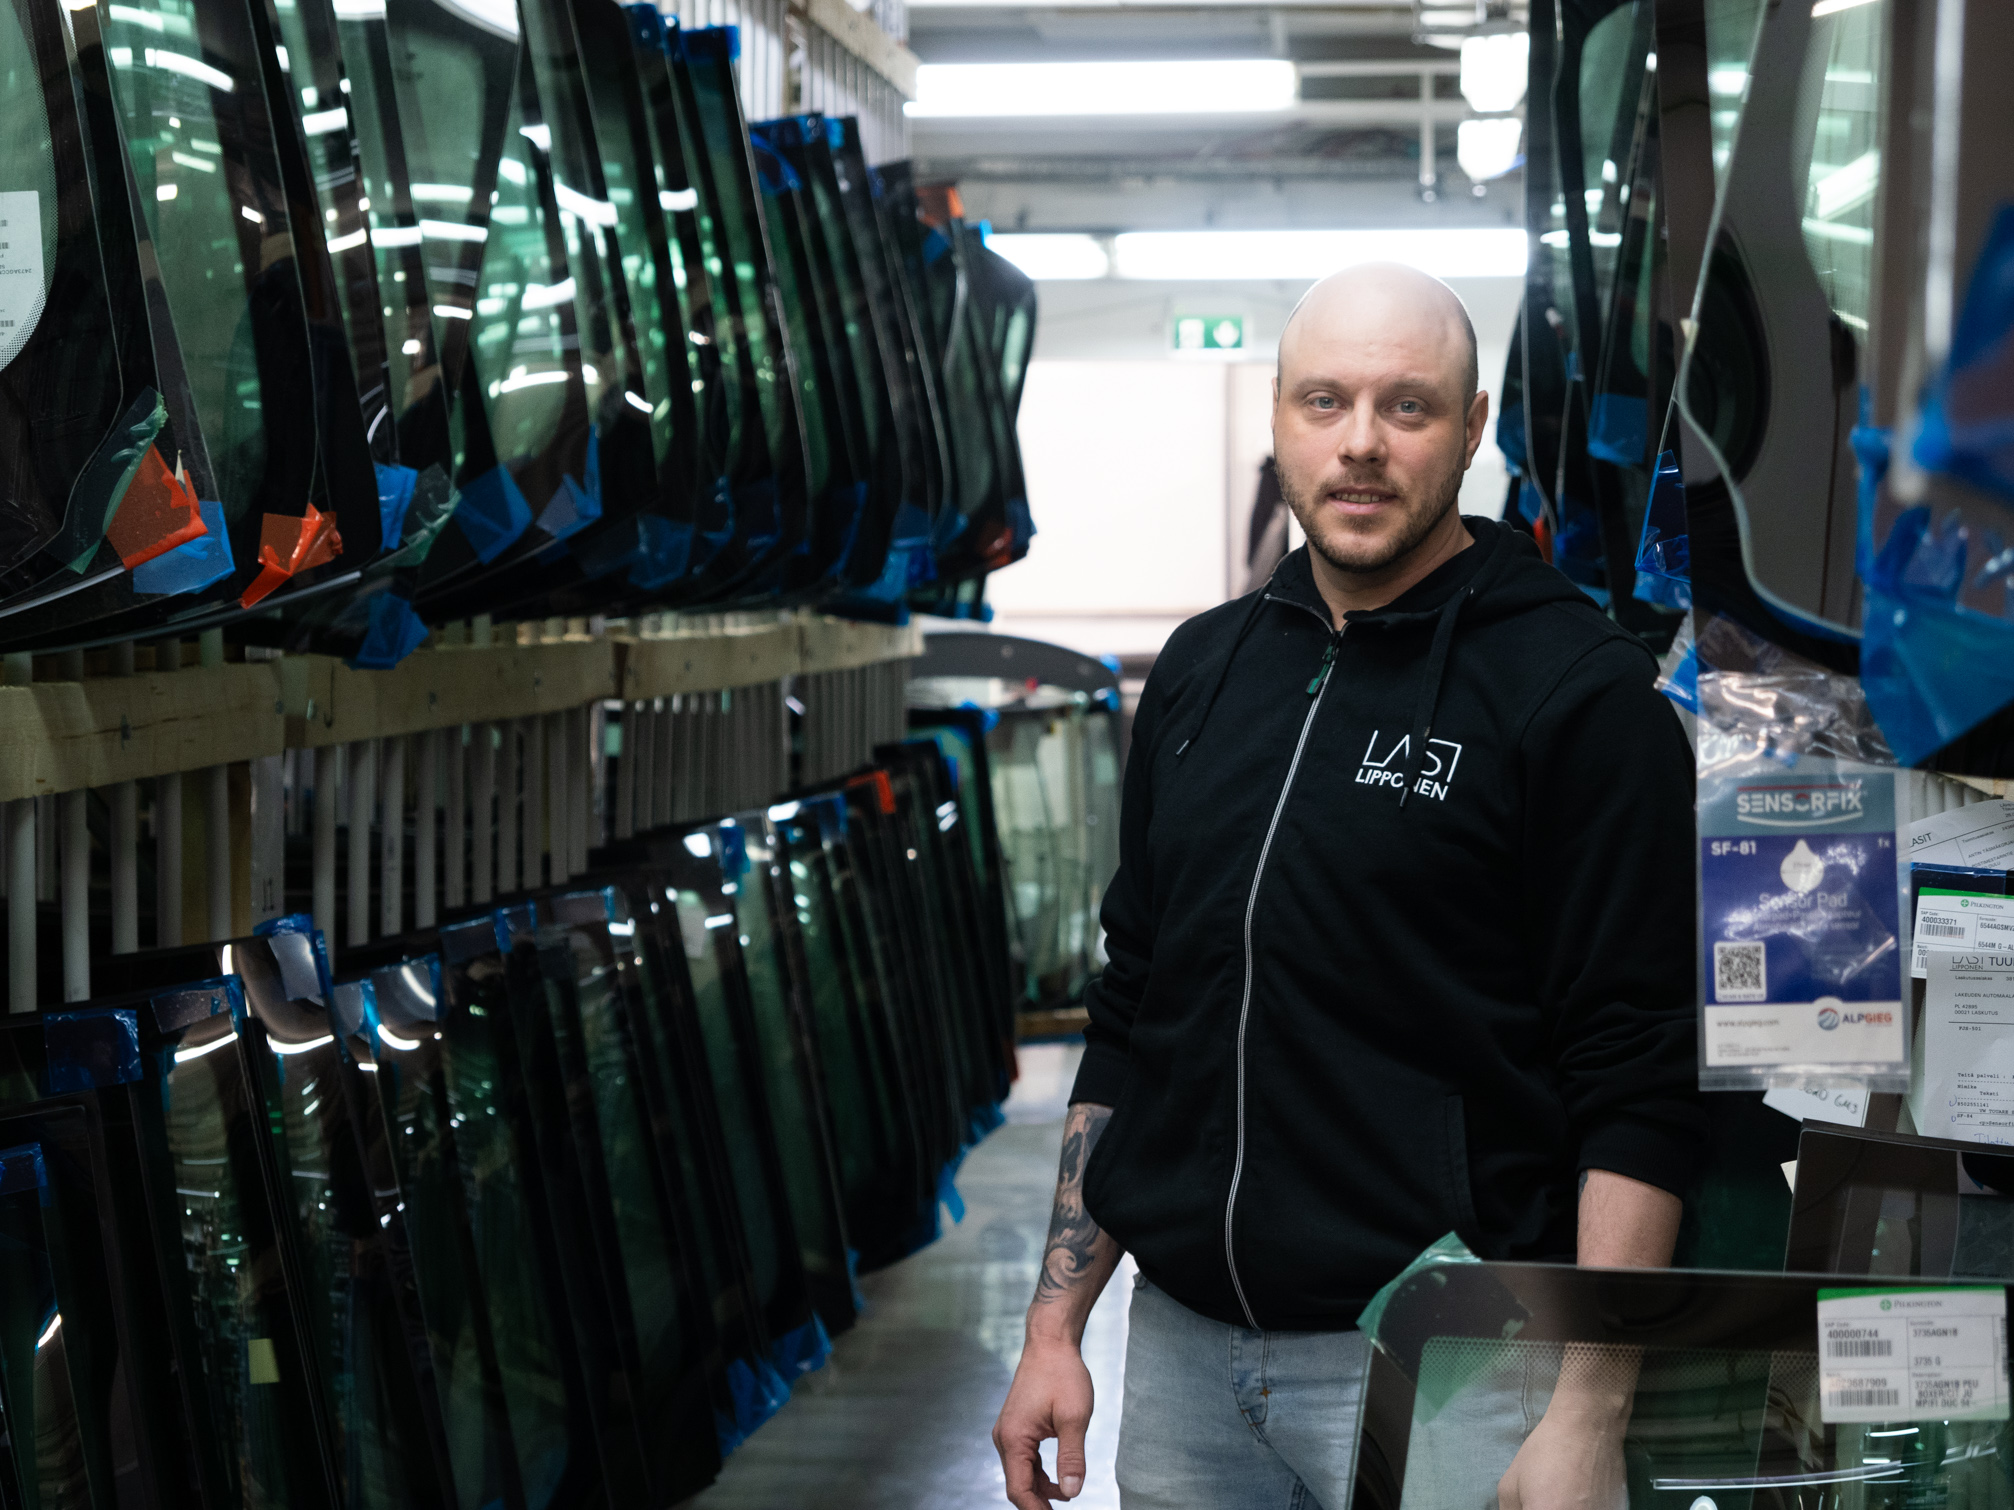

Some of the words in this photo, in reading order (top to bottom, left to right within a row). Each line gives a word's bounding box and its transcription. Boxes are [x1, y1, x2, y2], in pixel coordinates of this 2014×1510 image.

[1355, 768, 1449, 801] LIPPONEN
[1737, 791, 1863, 814] SENSORFIX
[1909, 832, 1932, 848] ASIT
[1982, 839, 2014, 853] TÄSMÄKORJA
[1711, 841, 1757, 856] SF-81
[1817, 891, 1848, 908] Pad
[1970, 901, 2004, 910] PILKINGTON
[1922, 916, 1957, 925] 400033371
[1978, 941, 1996, 949] 6544M
[1842, 1012, 1892, 1024] ALPGIEG
[1894, 1300, 1942, 1308] PILKINGTON
[1827, 1328, 1878, 1339] 400000744
[1914, 1356, 1933, 1366] 3735
